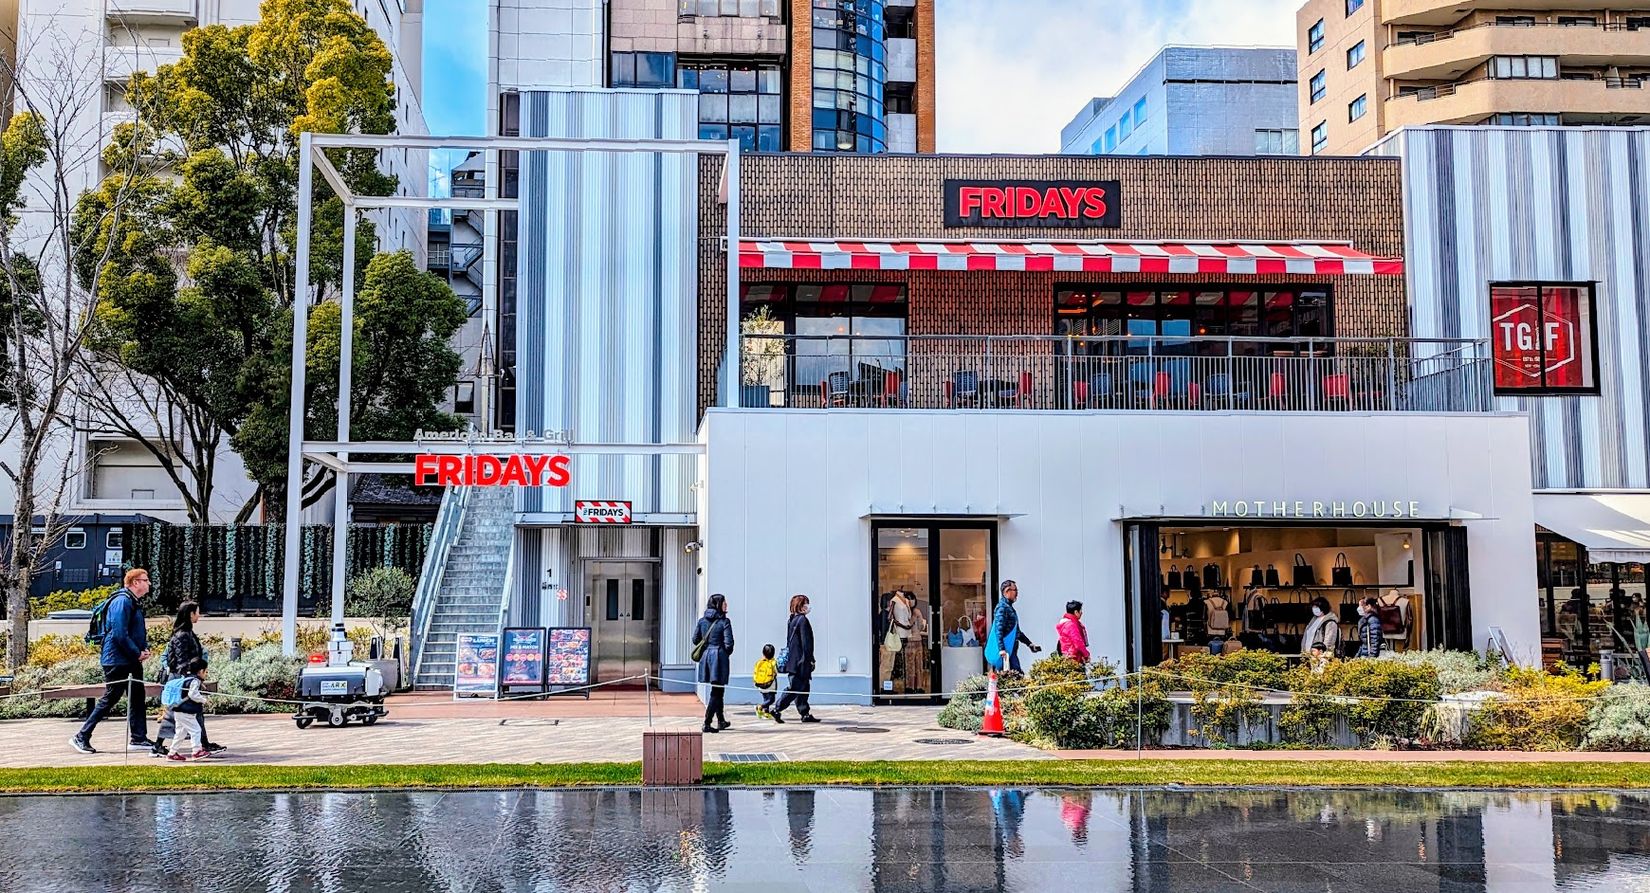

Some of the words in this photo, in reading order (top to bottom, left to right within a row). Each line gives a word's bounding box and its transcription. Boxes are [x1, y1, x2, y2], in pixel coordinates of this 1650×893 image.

[959, 186, 1106, 218] FRIDAYS
[413, 428, 488, 441] American
[414, 454, 571, 487] FRIDAYS
[588, 508, 624, 517] FRIDAYS
[1212, 500, 1420, 517] MOTHERHOUSE
[547, 568, 552, 577] 1
